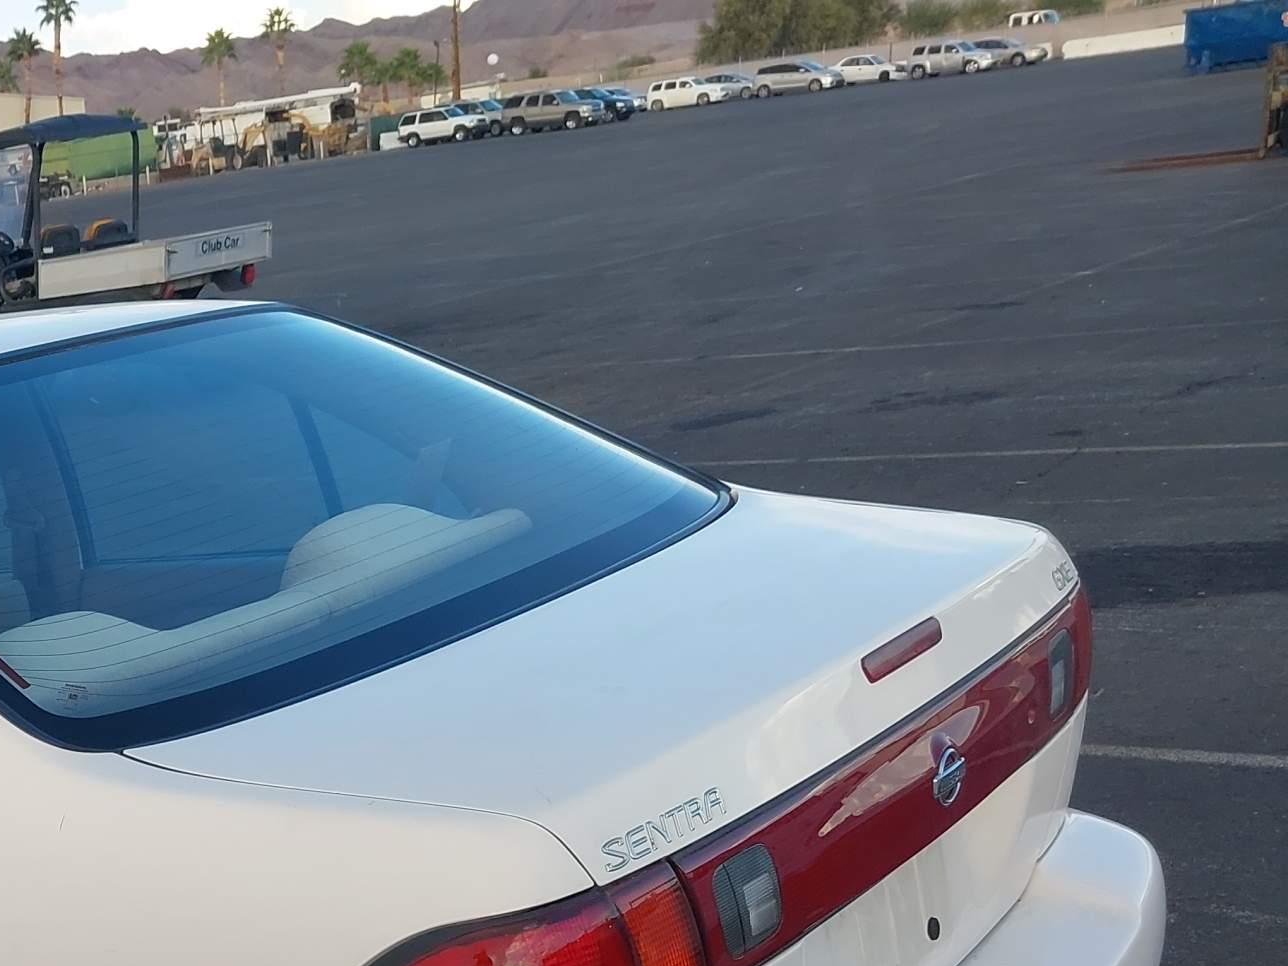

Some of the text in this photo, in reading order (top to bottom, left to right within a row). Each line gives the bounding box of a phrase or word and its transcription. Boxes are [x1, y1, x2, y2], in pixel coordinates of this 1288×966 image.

[201, 236, 240, 255] Club Car
[600, 786, 727, 873] SENTRA
